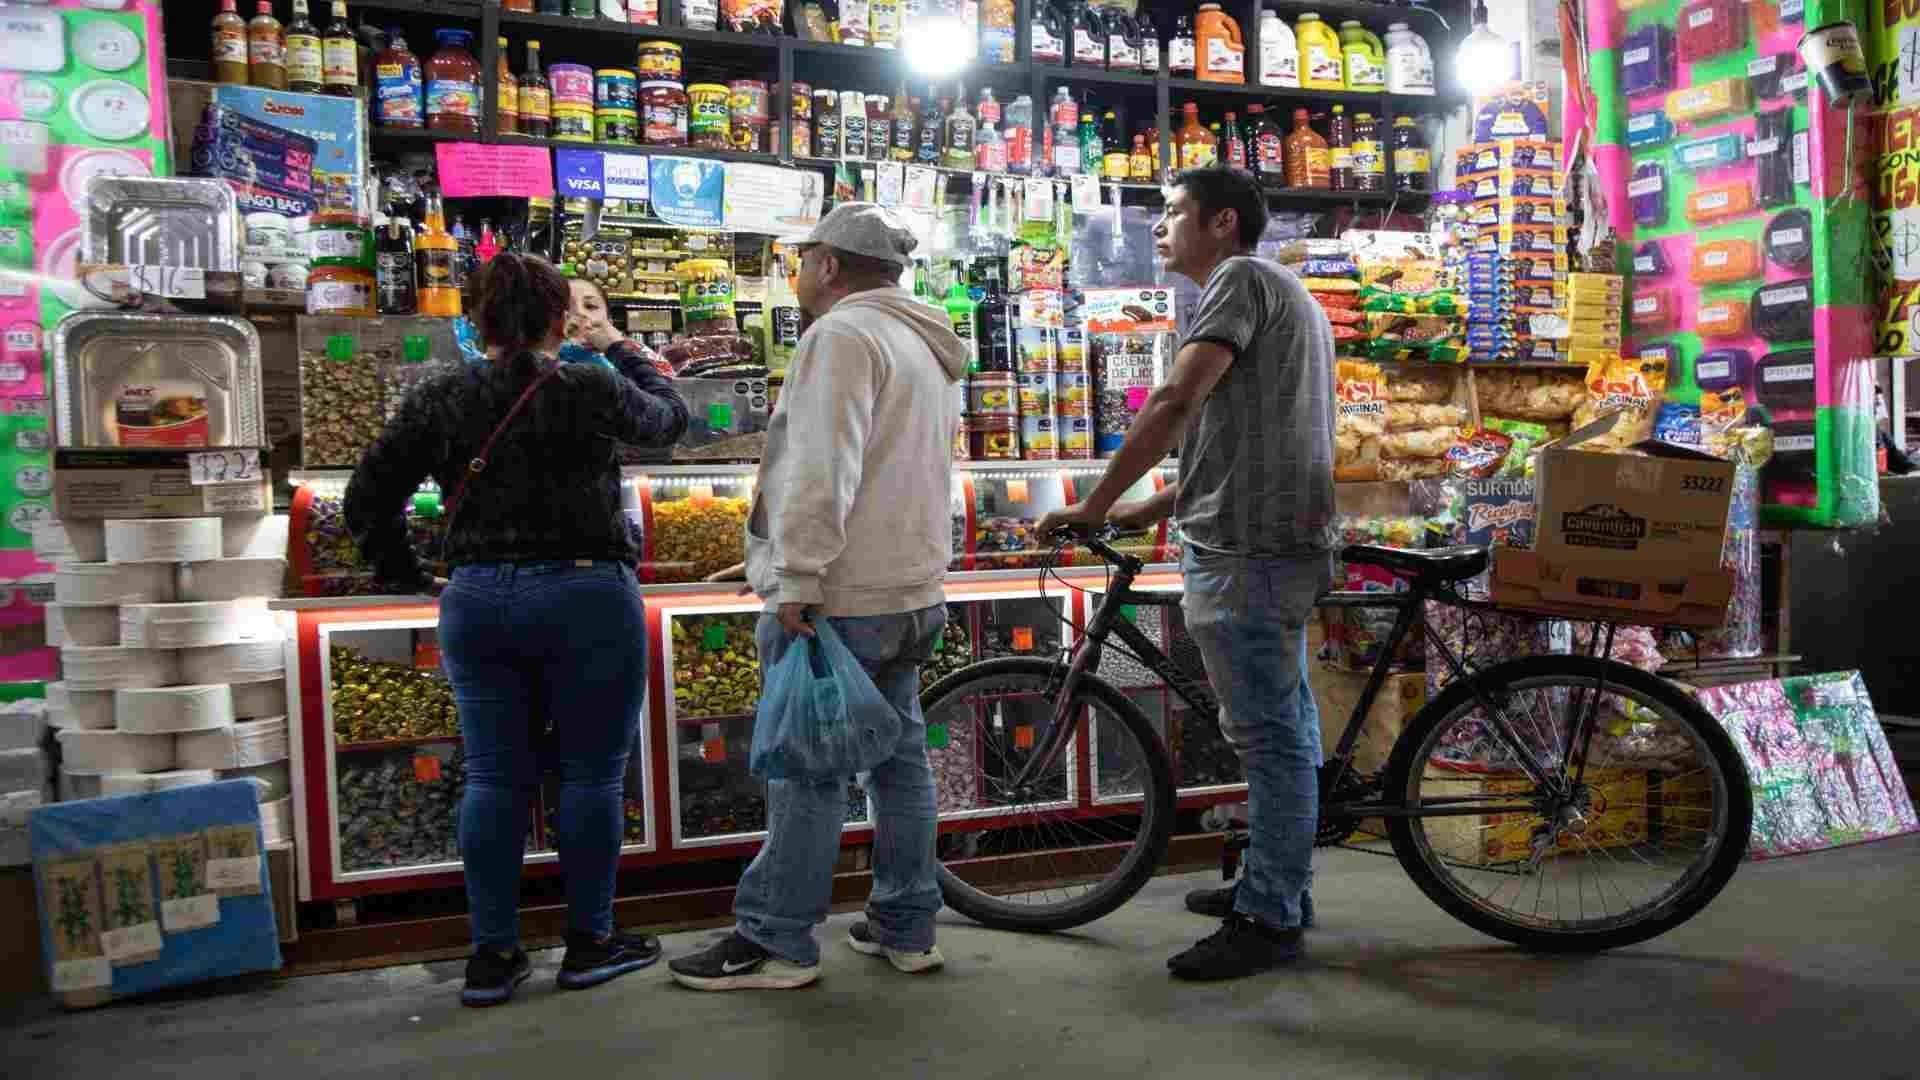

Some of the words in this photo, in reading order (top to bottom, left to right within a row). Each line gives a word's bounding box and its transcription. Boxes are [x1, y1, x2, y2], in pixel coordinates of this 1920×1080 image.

[568, 178, 600, 191] VISA
[1112, 355, 1153, 367] CREMA
[1112, 368, 1128, 377] DE
